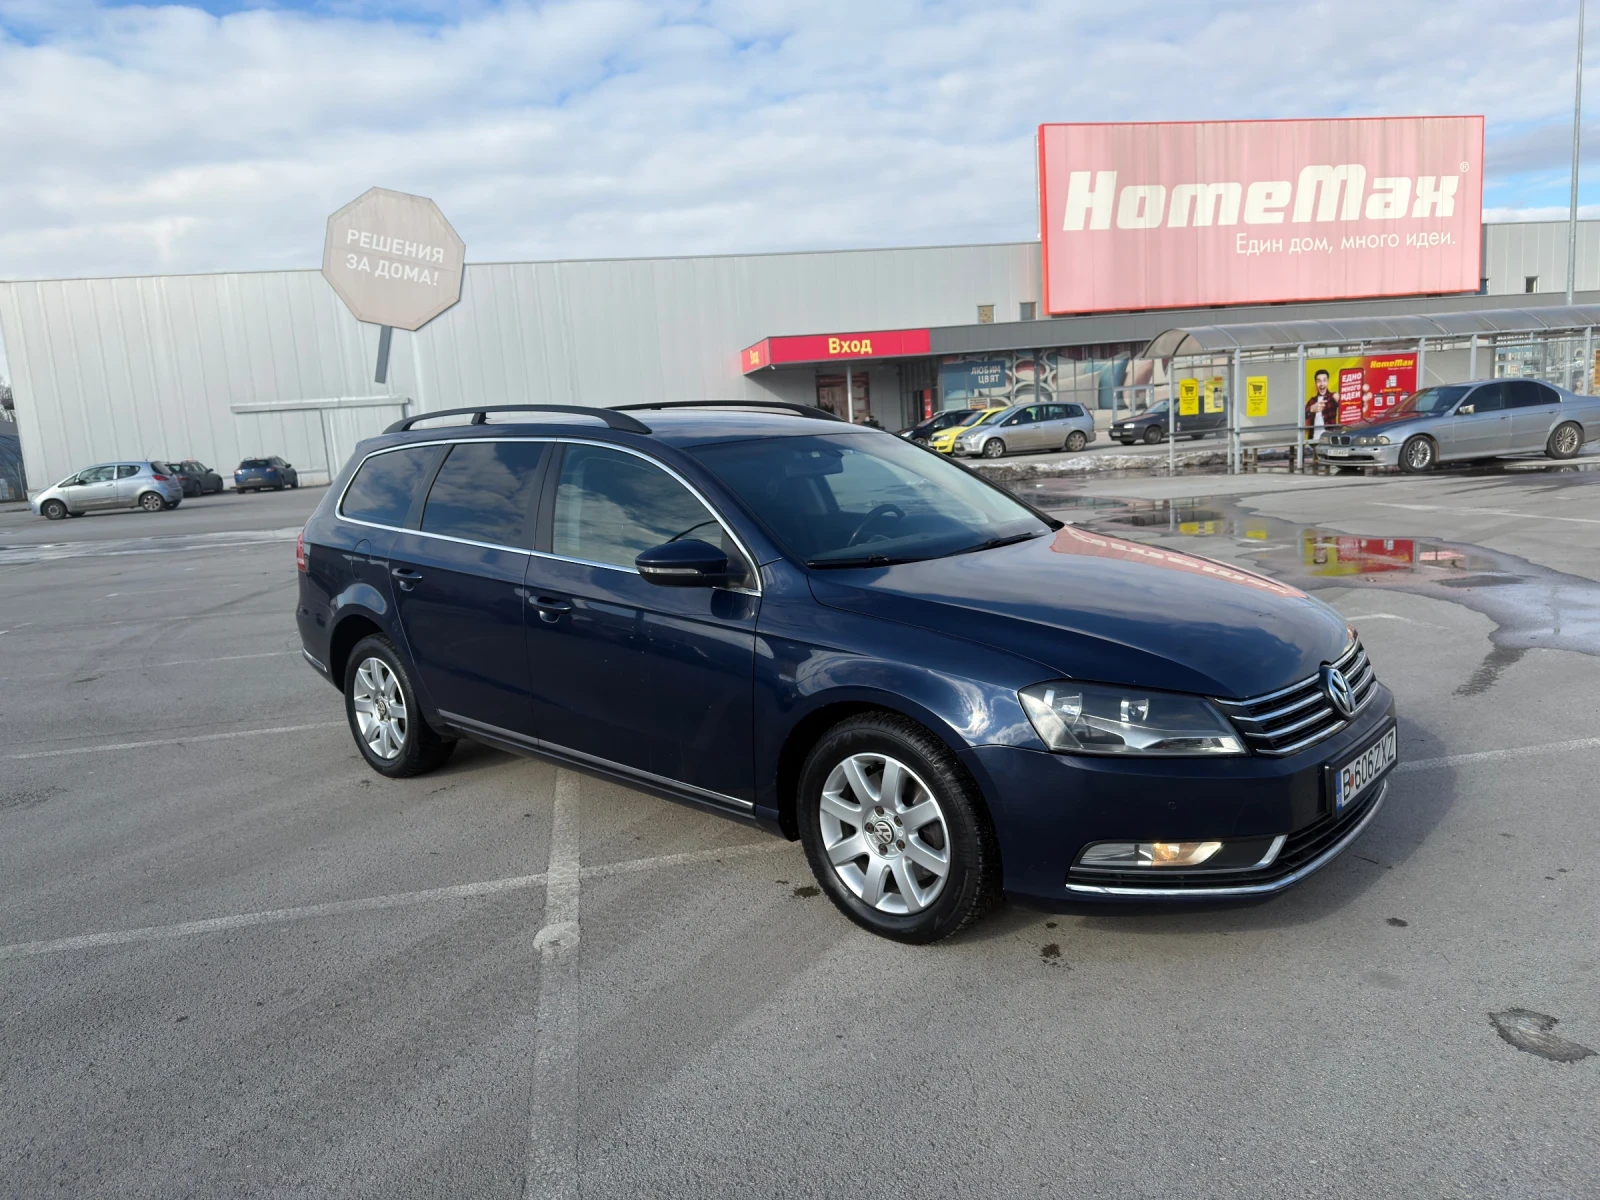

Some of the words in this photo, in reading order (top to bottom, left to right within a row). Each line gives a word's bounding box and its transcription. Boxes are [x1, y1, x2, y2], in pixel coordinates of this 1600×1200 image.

[346, 229, 444, 263] РЕШЕНИЯ
[1236, 232, 1283, 255] Един
[1289, 234, 1333, 255] дом,
[1341, 233, 1399, 250] много
[1406, 230, 1456, 249] идеи.
[345, 254, 371, 273] ЗА
[375, 261, 439, 286] ДОМА!
[828, 338, 872, 354] Вход
[971, 365, 1001, 375] ЛЮБИМ
[978, 374, 1000, 384] ЦВЯТ
[1342, 372, 1362, 383] ЕДНО
[1341, 391, 1361, 401] ИДЕИ
